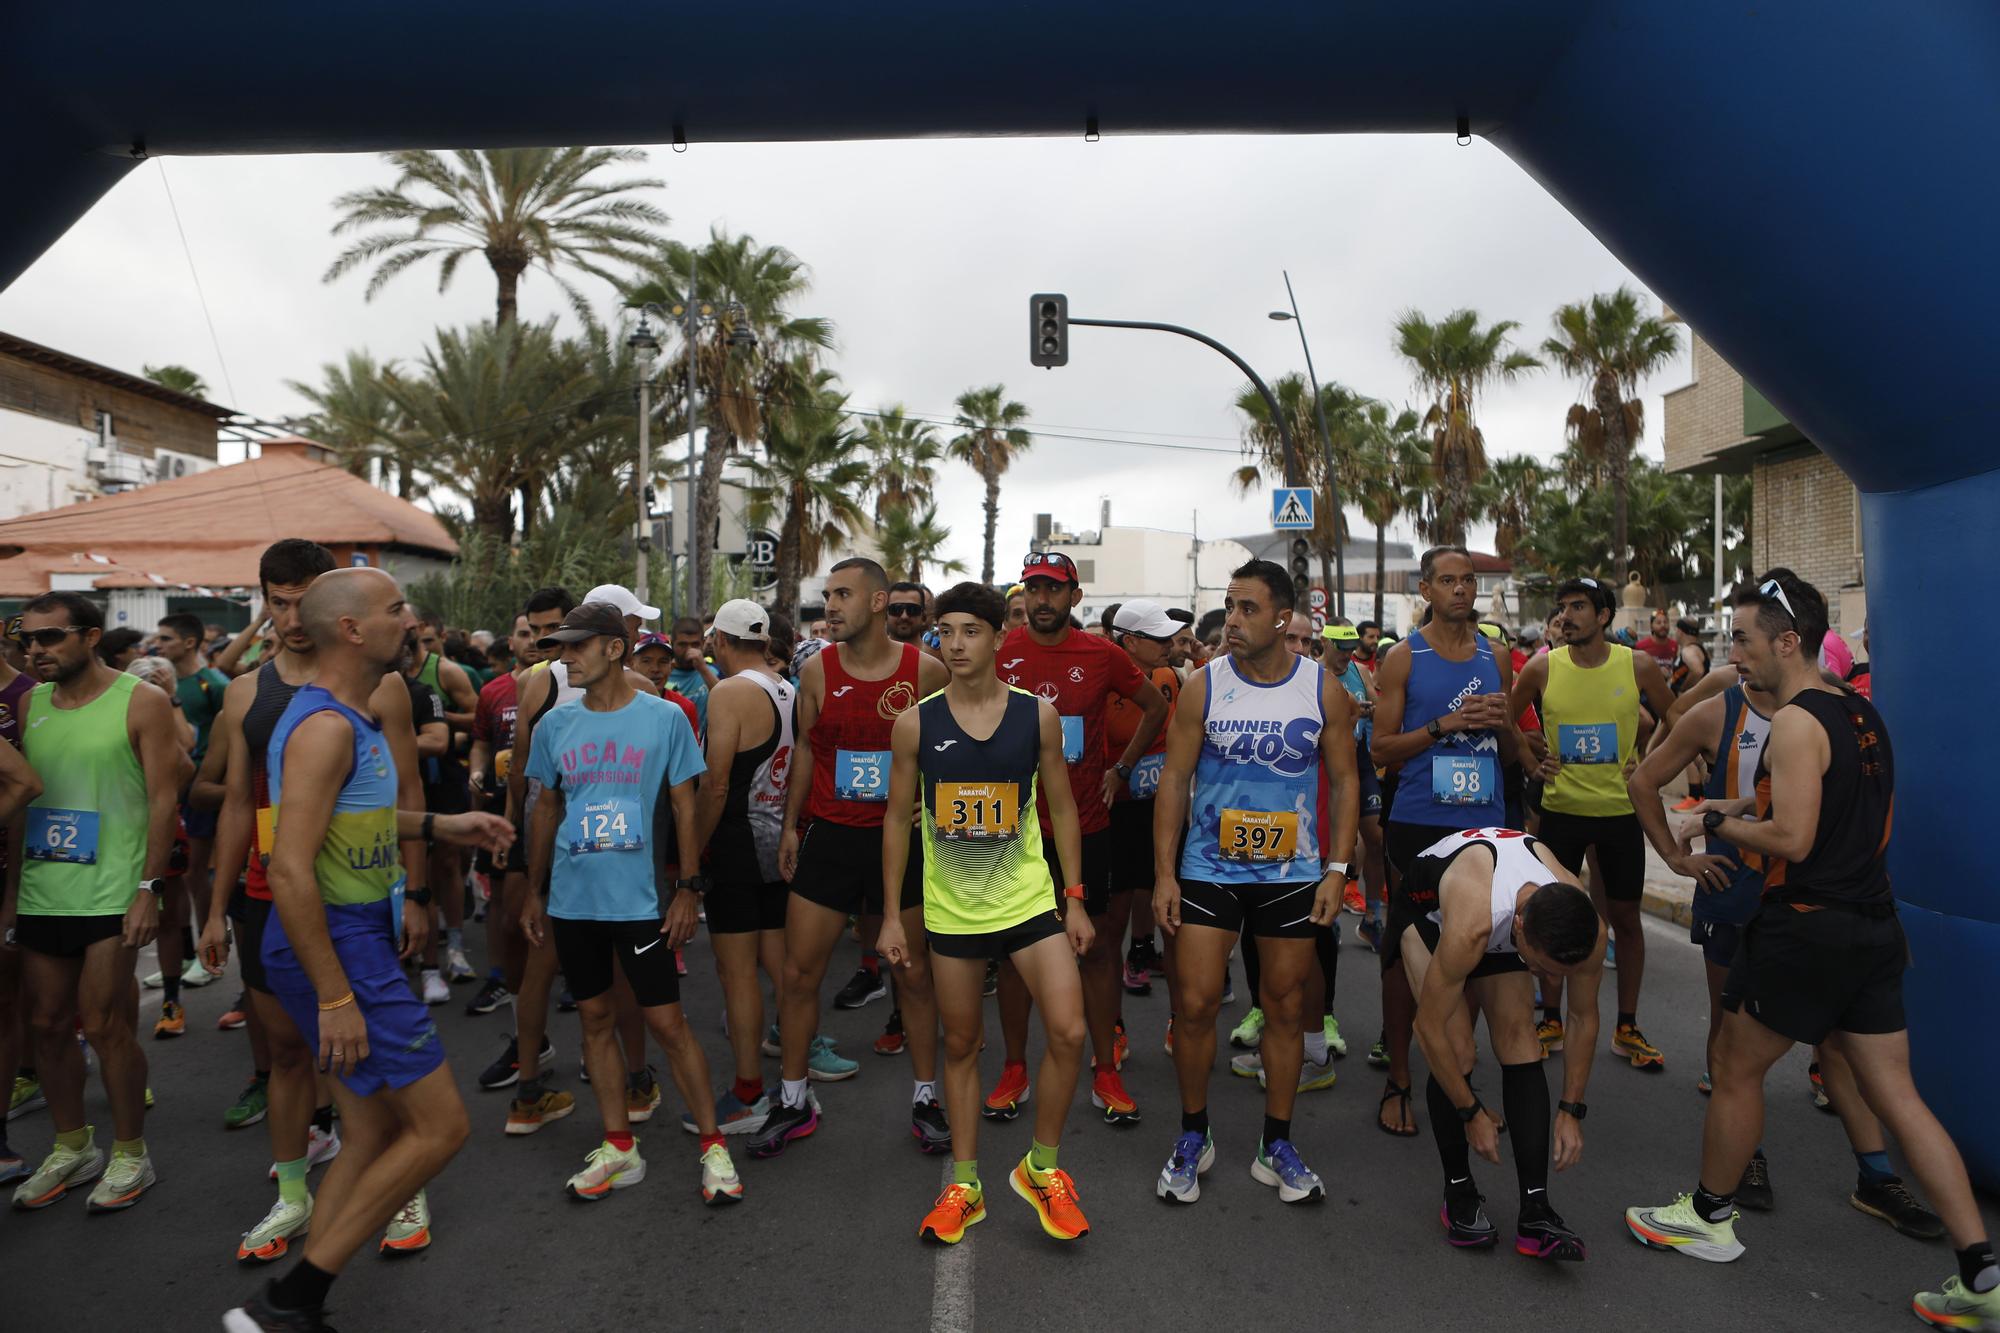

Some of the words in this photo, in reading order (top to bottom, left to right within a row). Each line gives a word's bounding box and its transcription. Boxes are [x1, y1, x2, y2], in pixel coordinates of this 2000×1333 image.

[1311, 594, 1323, 603] 30
[1208, 720, 1283, 733] RUNNER
[562, 740, 646, 771] UCAM
[1575, 736, 1601, 754] 43
[852, 766, 882, 788] 23
[1138, 765, 1165, 787] 20
[1452, 771, 1480, 792] 98
[952, 799, 1003, 825] 311
[47, 824, 78, 848] 62
[580, 813, 628, 839] 124
[1233, 825, 1285, 850] 397
